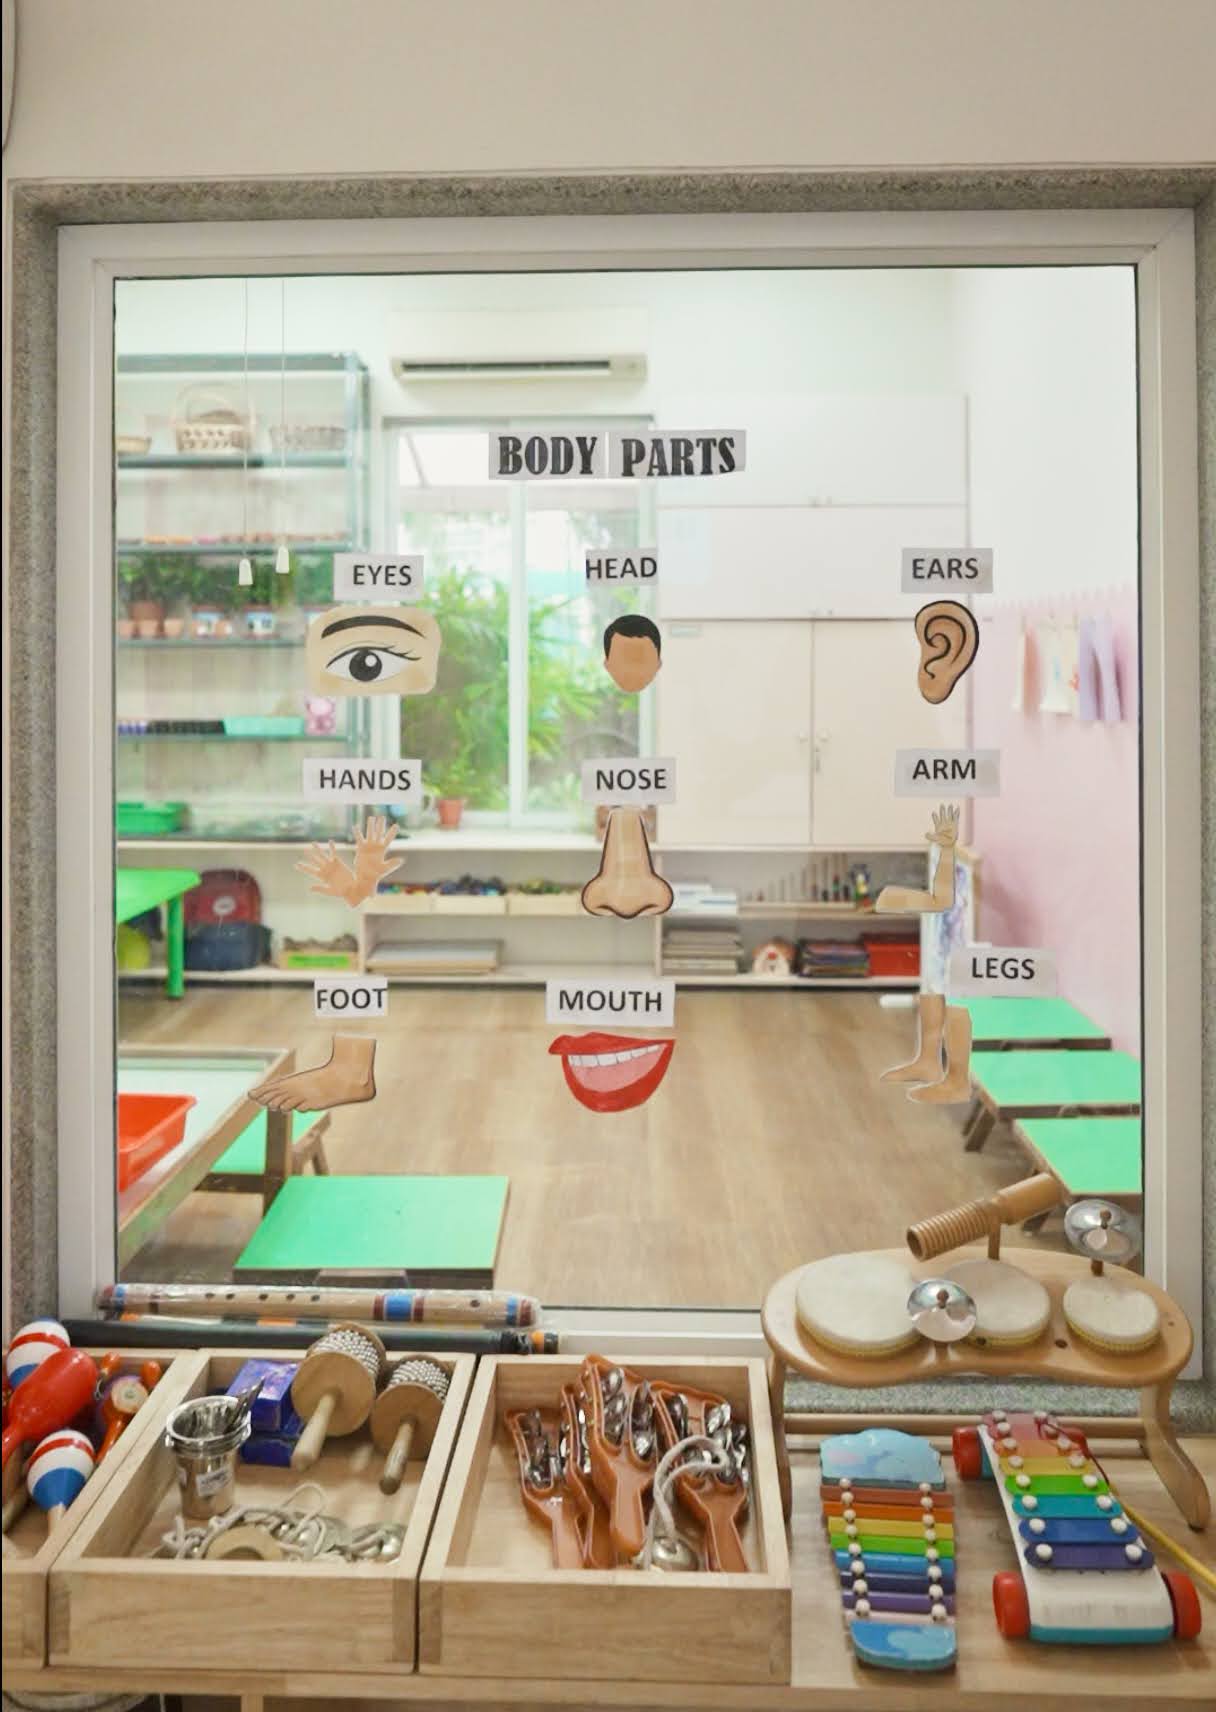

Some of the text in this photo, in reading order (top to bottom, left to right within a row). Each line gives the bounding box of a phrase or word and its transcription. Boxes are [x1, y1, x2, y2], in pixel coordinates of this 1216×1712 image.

[498, 435, 737, 477] BODY PARTS
[352, 563, 413, 587] EYES
[586, 556, 658, 580] HEAD
[912, 557, 979, 581] EARS
[319, 768, 412, 792] HANDS
[595, 767, 668, 791] NOSE
[912, 758, 977, 781] ARM
[972, 956, 1036, 981] LEGS
[317, 987, 388, 1010] FOOT
[559, 989, 663, 1013] MOUTH
